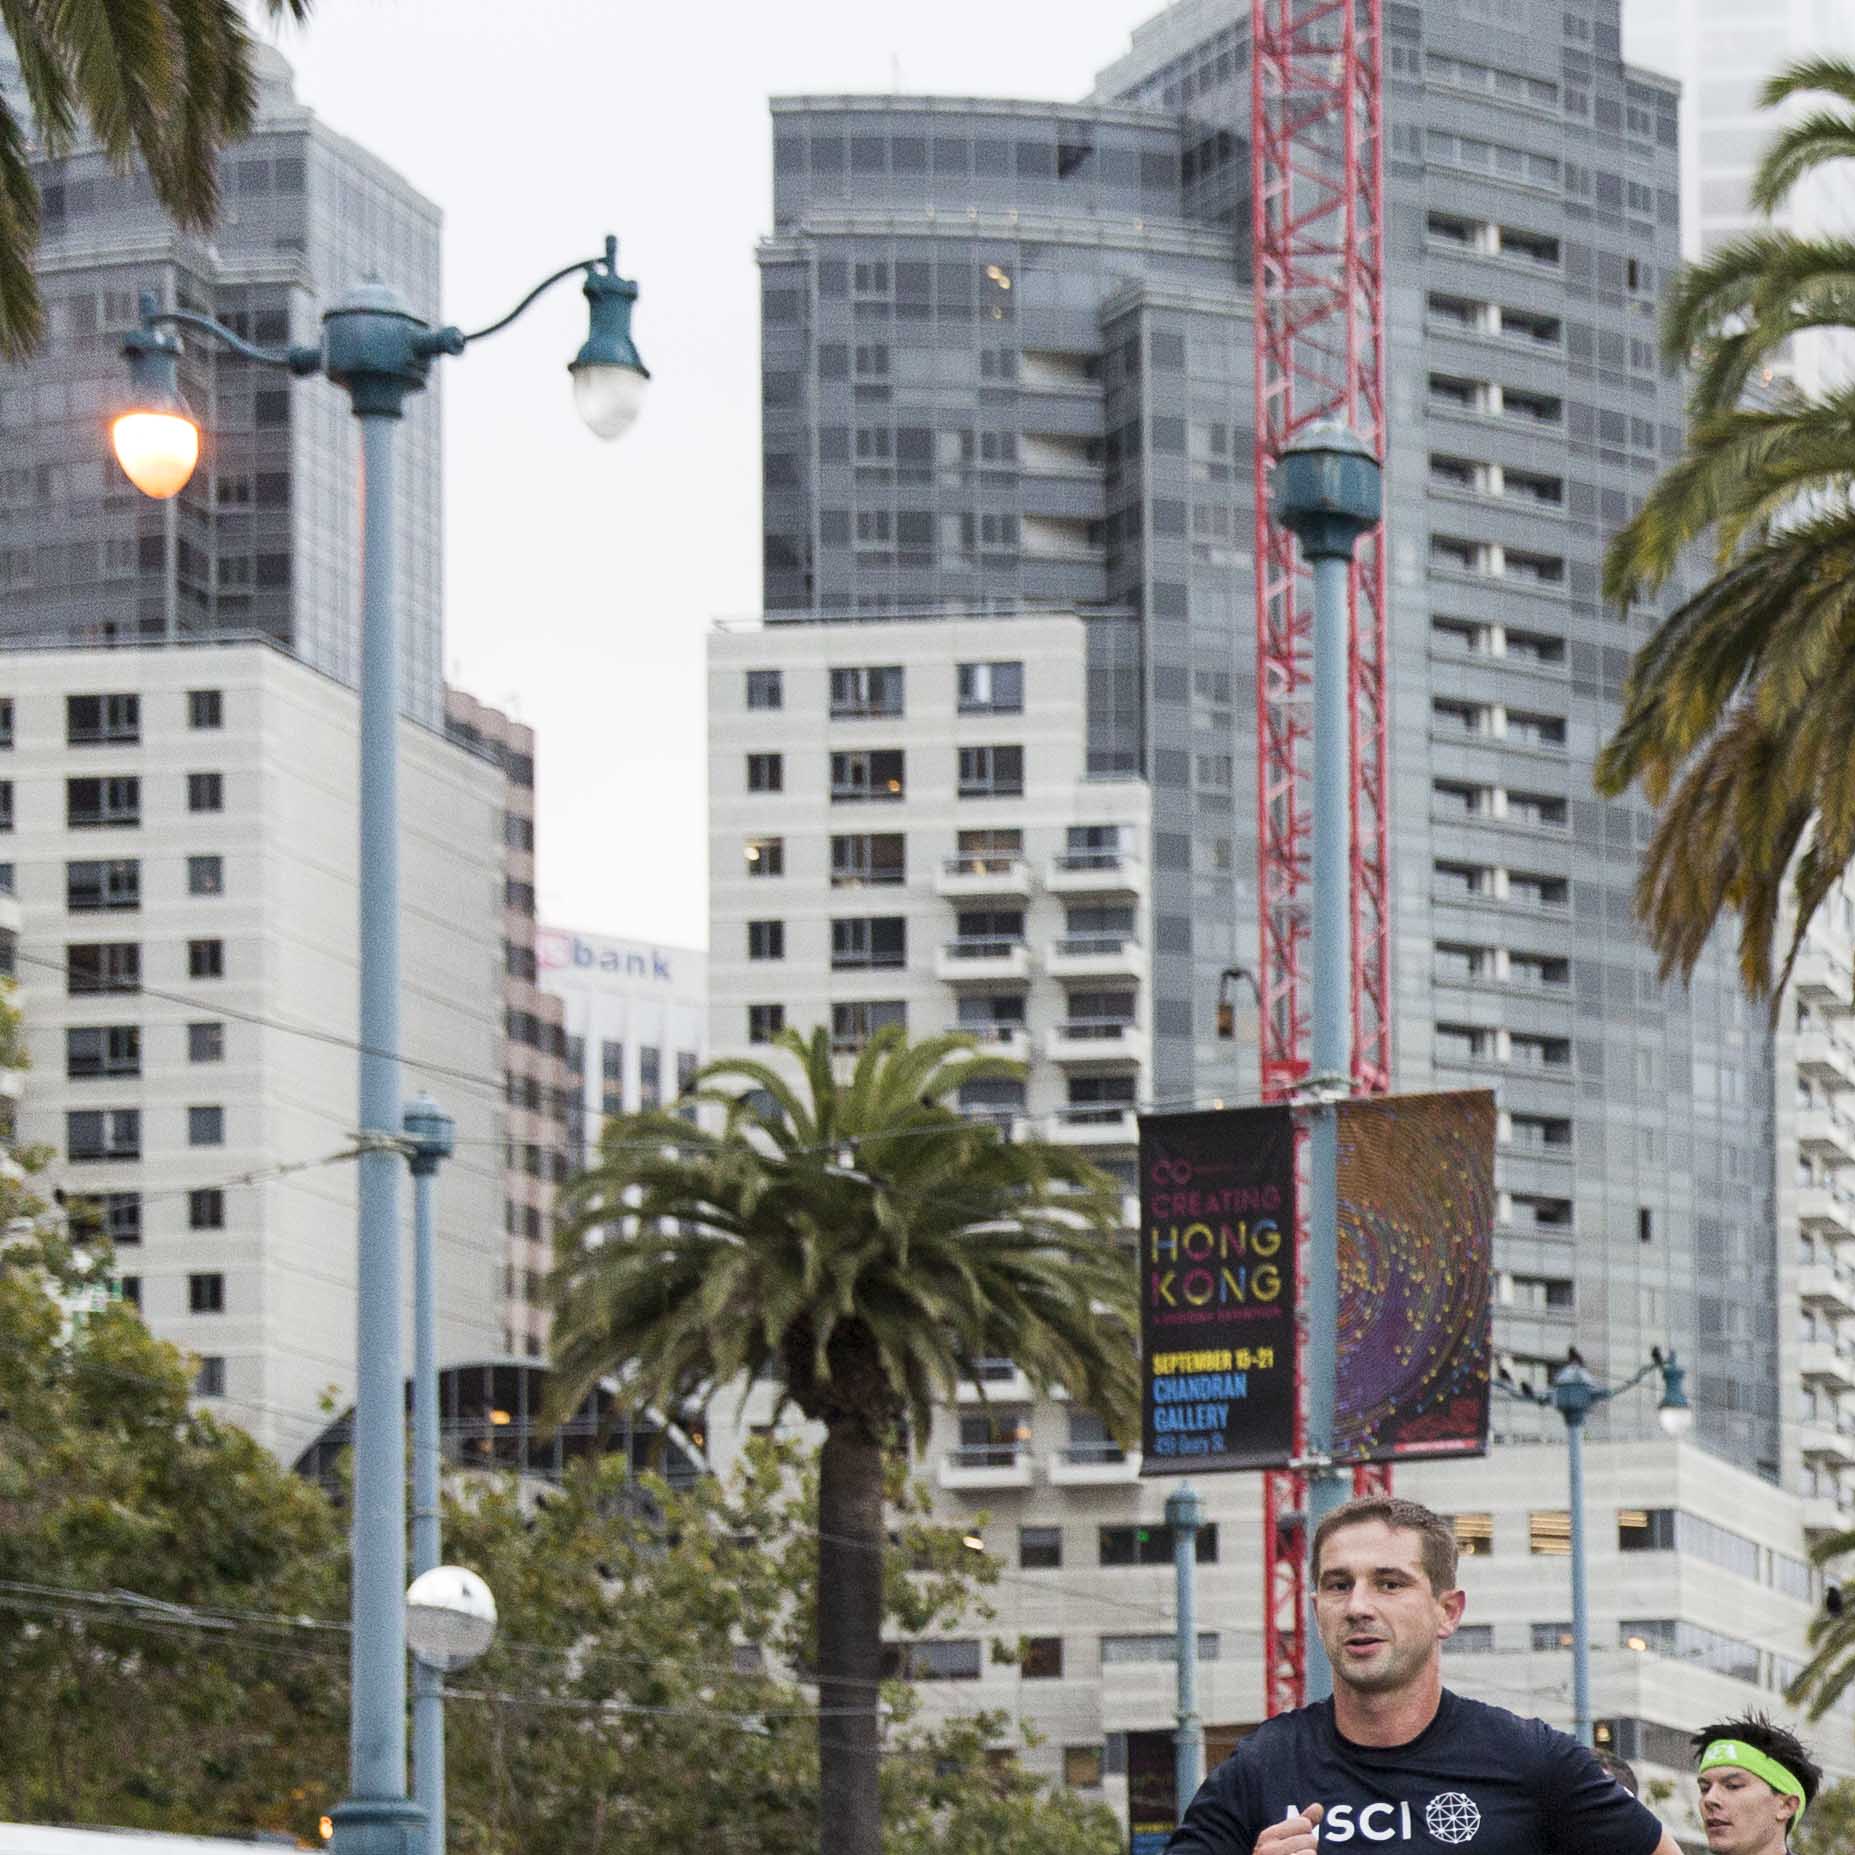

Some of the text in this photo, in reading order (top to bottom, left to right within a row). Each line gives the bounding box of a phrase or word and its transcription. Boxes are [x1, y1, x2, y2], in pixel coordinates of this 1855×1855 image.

[573, 936, 674, 983] bank
[1152, 1184, 1281, 1218] CREATING
[1151, 1218, 1281, 1264] HONG
[1151, 1262, 1281, 1307] KONG
[1152, 1350, 1232, 1375] SEPTEMBER
[1153, 1372, 1248, 1404] CHANDRAN
[1153, 1402, 1230, 1432] GALLERY
